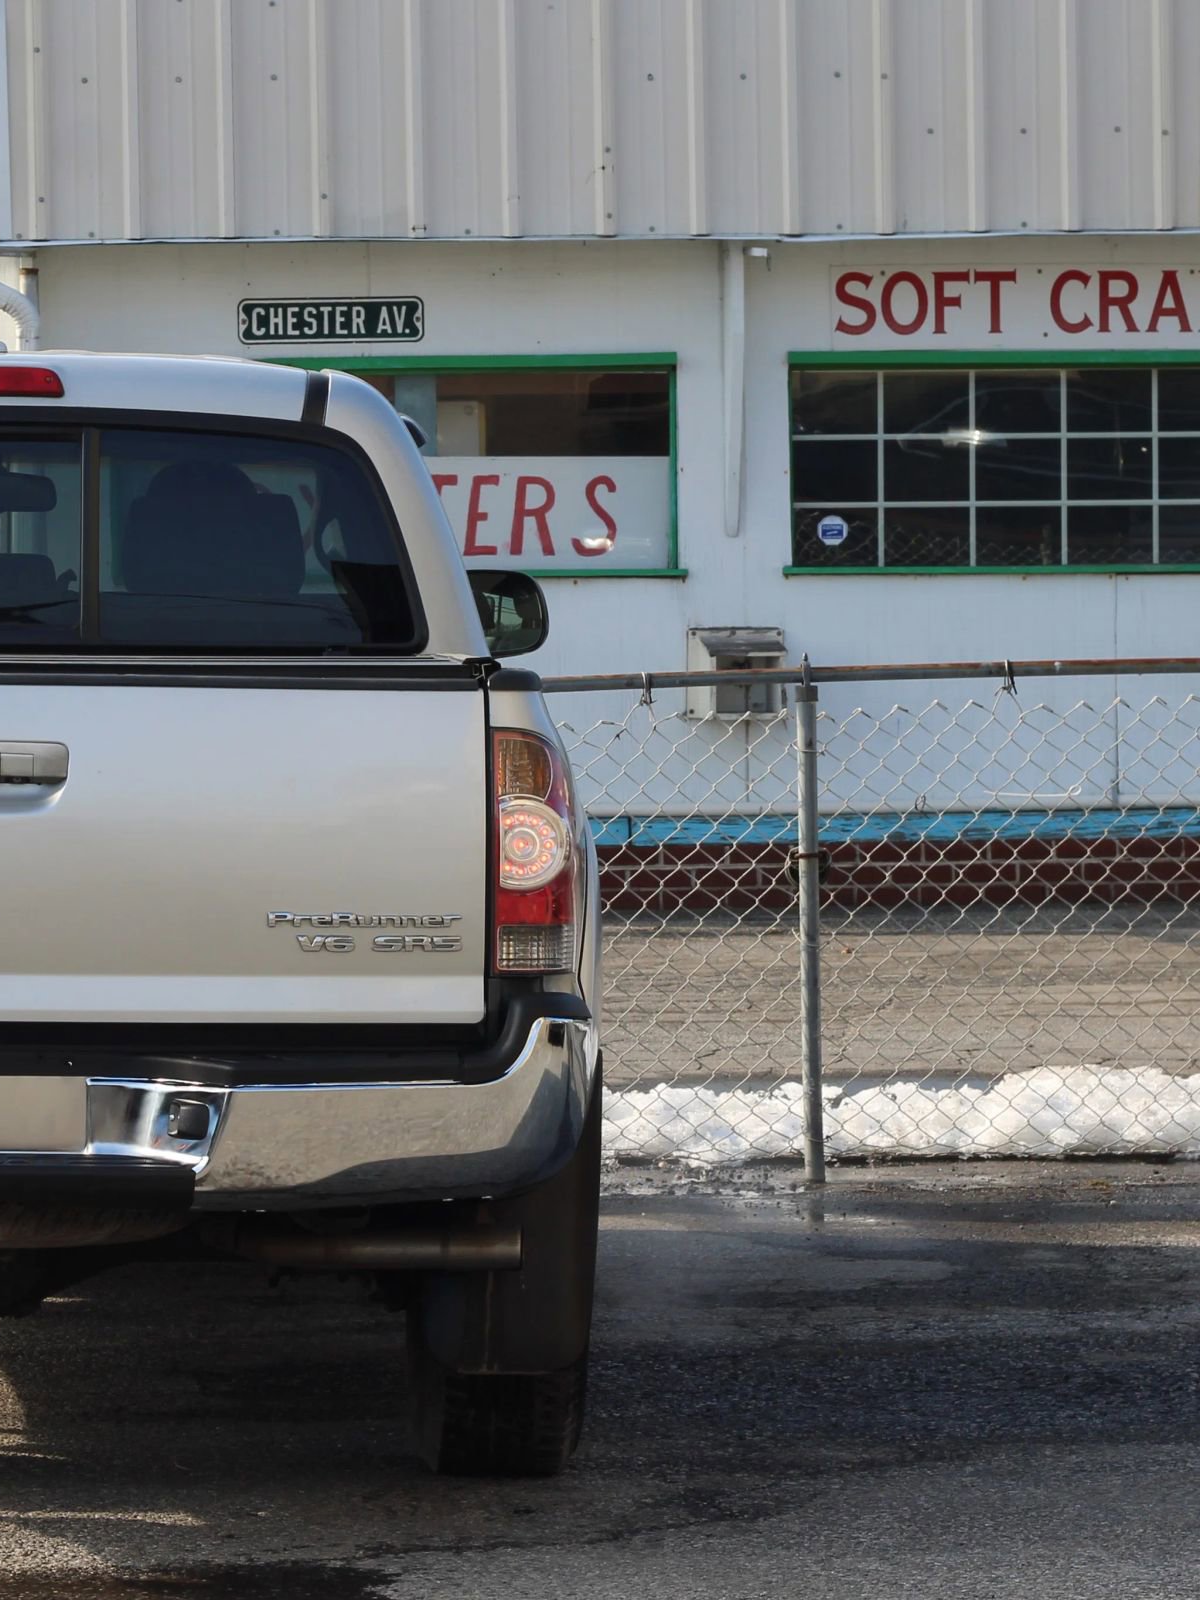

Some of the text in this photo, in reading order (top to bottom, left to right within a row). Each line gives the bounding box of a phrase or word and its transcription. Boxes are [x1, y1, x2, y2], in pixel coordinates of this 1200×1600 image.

[834, 268, 1200, 336] SOFT CRA
[251, 305, 410, 336] CHESTER AV.
[266, 911, 463, 929] PreRunner
[296, 934, 463, 953] V6 SR5
